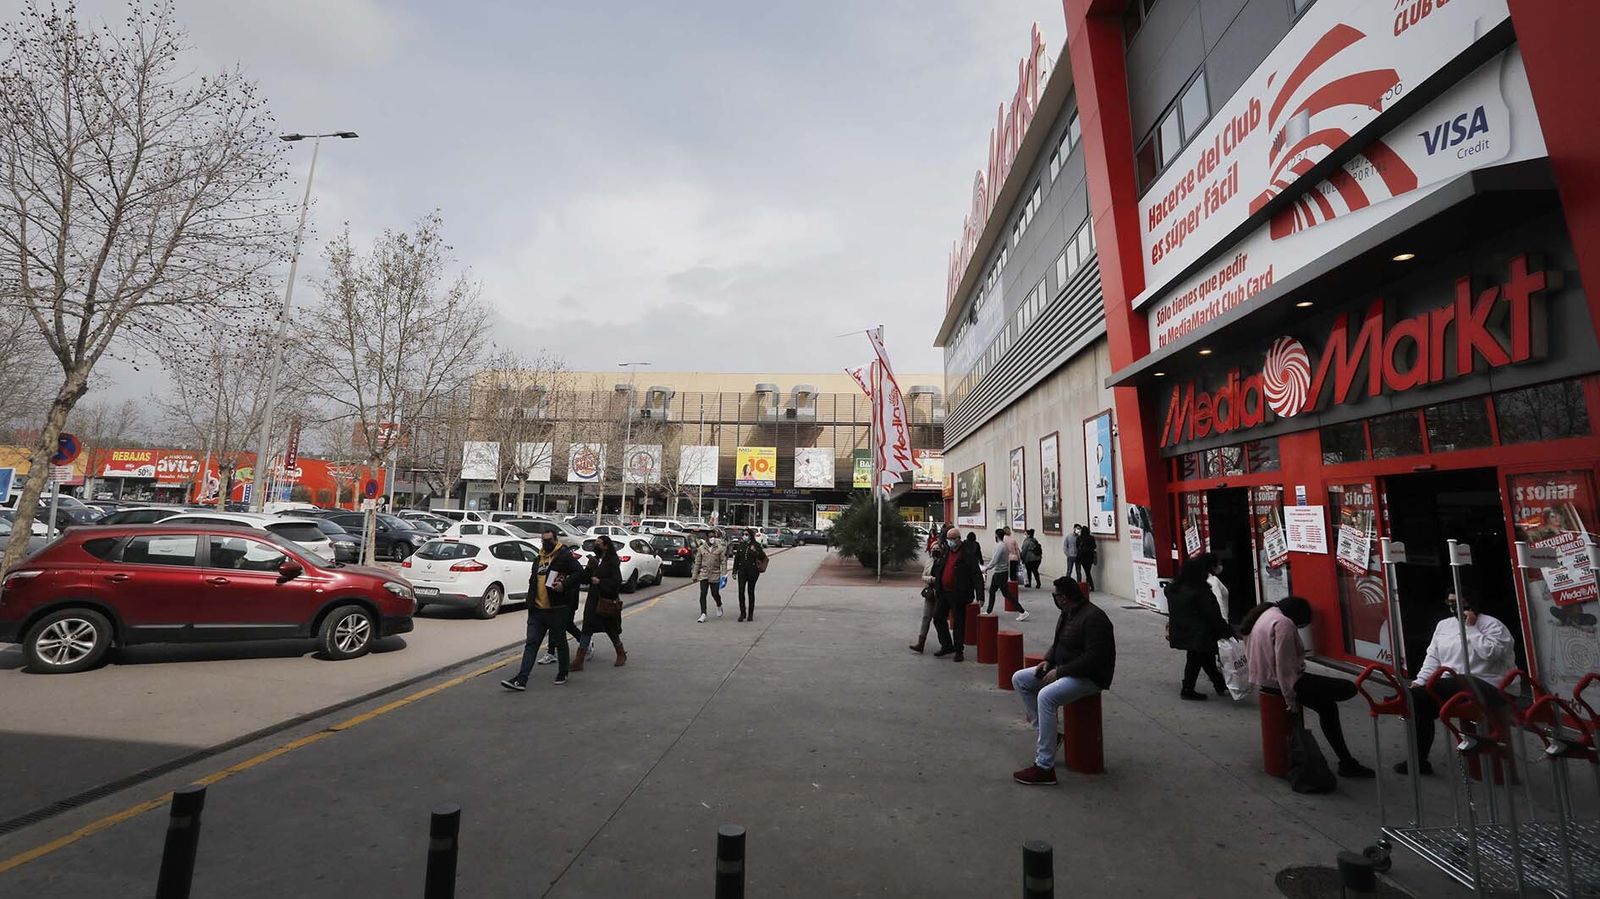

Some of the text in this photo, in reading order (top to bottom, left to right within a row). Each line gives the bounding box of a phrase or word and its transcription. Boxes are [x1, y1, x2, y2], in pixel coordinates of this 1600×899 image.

[1417, 105, 1489, 156] VISA
[1457, 140, 1490, 160] Credit
[1148, 96, 1261, 233] Hacerse del Club
[1151, 160, 1239, 266] es súper fácil
[1156, 253, 1248, 328] Sólo tienes que pedir
[1158, 263, 1274, 349] tu MediaMarkt Club Card
[1160, 252, 1546, 448] Media Markt
[112, 451, 152, 462] REBAJAS
[157, 456, 201, 474] ávila
[137, 468, 153, 477] 50%
[1526, 480, 1578, 501] soñar
[1535, 532, 1574, 550] DESCUENTO
[1560, 540, 1585, 552] DIRECTO
